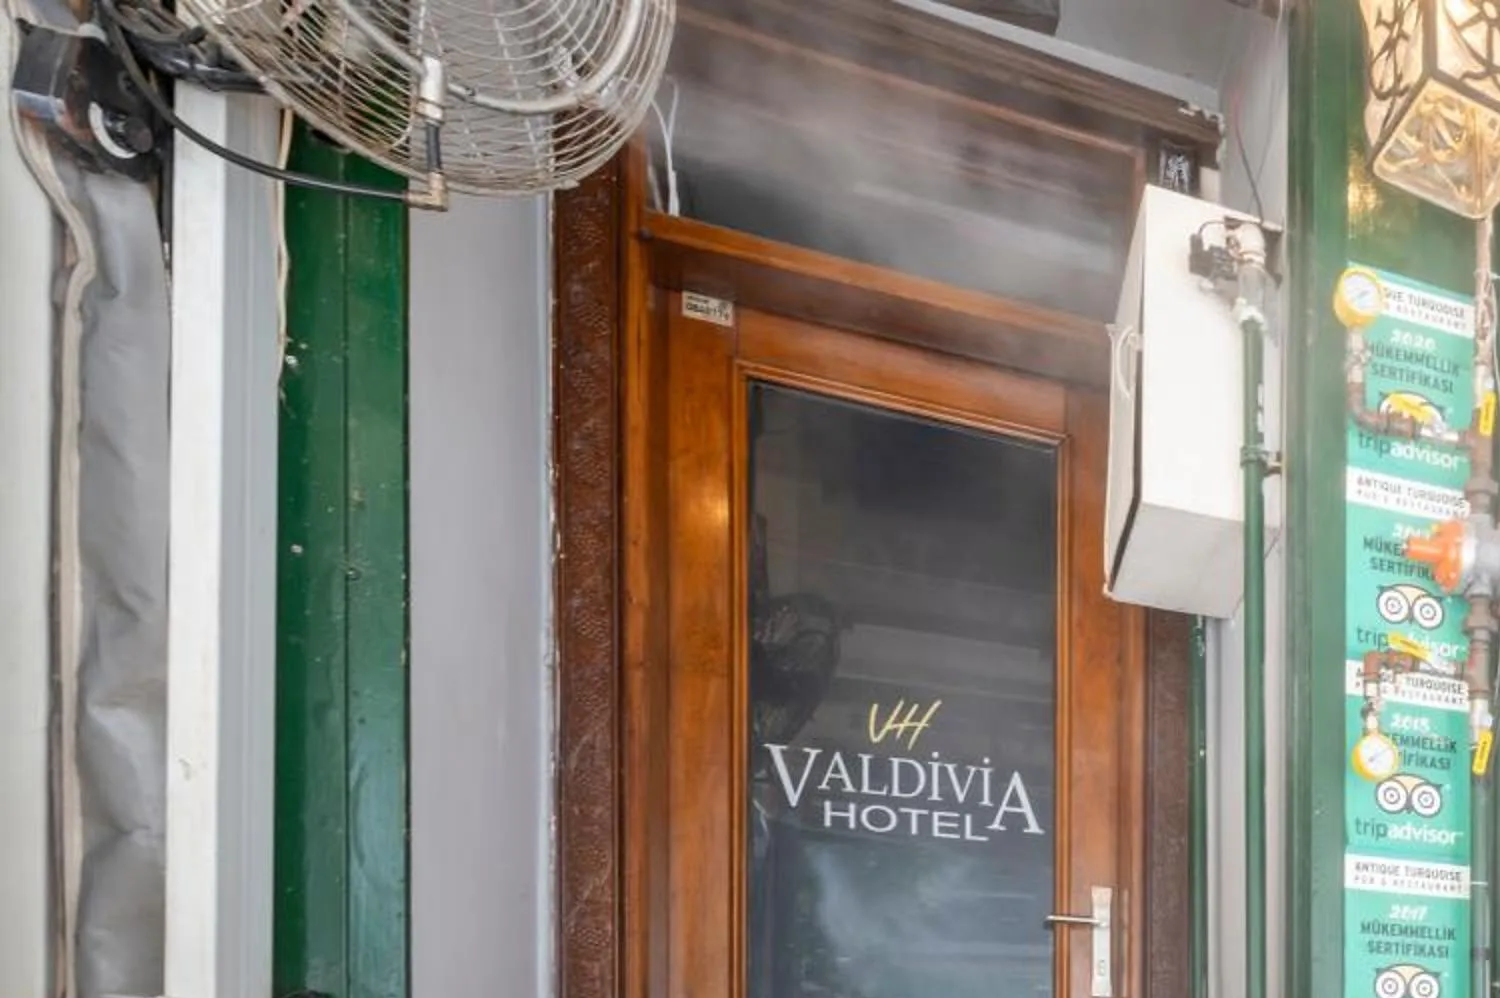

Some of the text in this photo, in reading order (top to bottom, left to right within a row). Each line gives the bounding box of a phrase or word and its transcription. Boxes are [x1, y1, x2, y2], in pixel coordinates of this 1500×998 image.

[823, 800, 990, 842] HOTEL
[1355, 816, 1459, 845] tripadvisor
[1354, 861, 1401, 877] ANTIQUE
